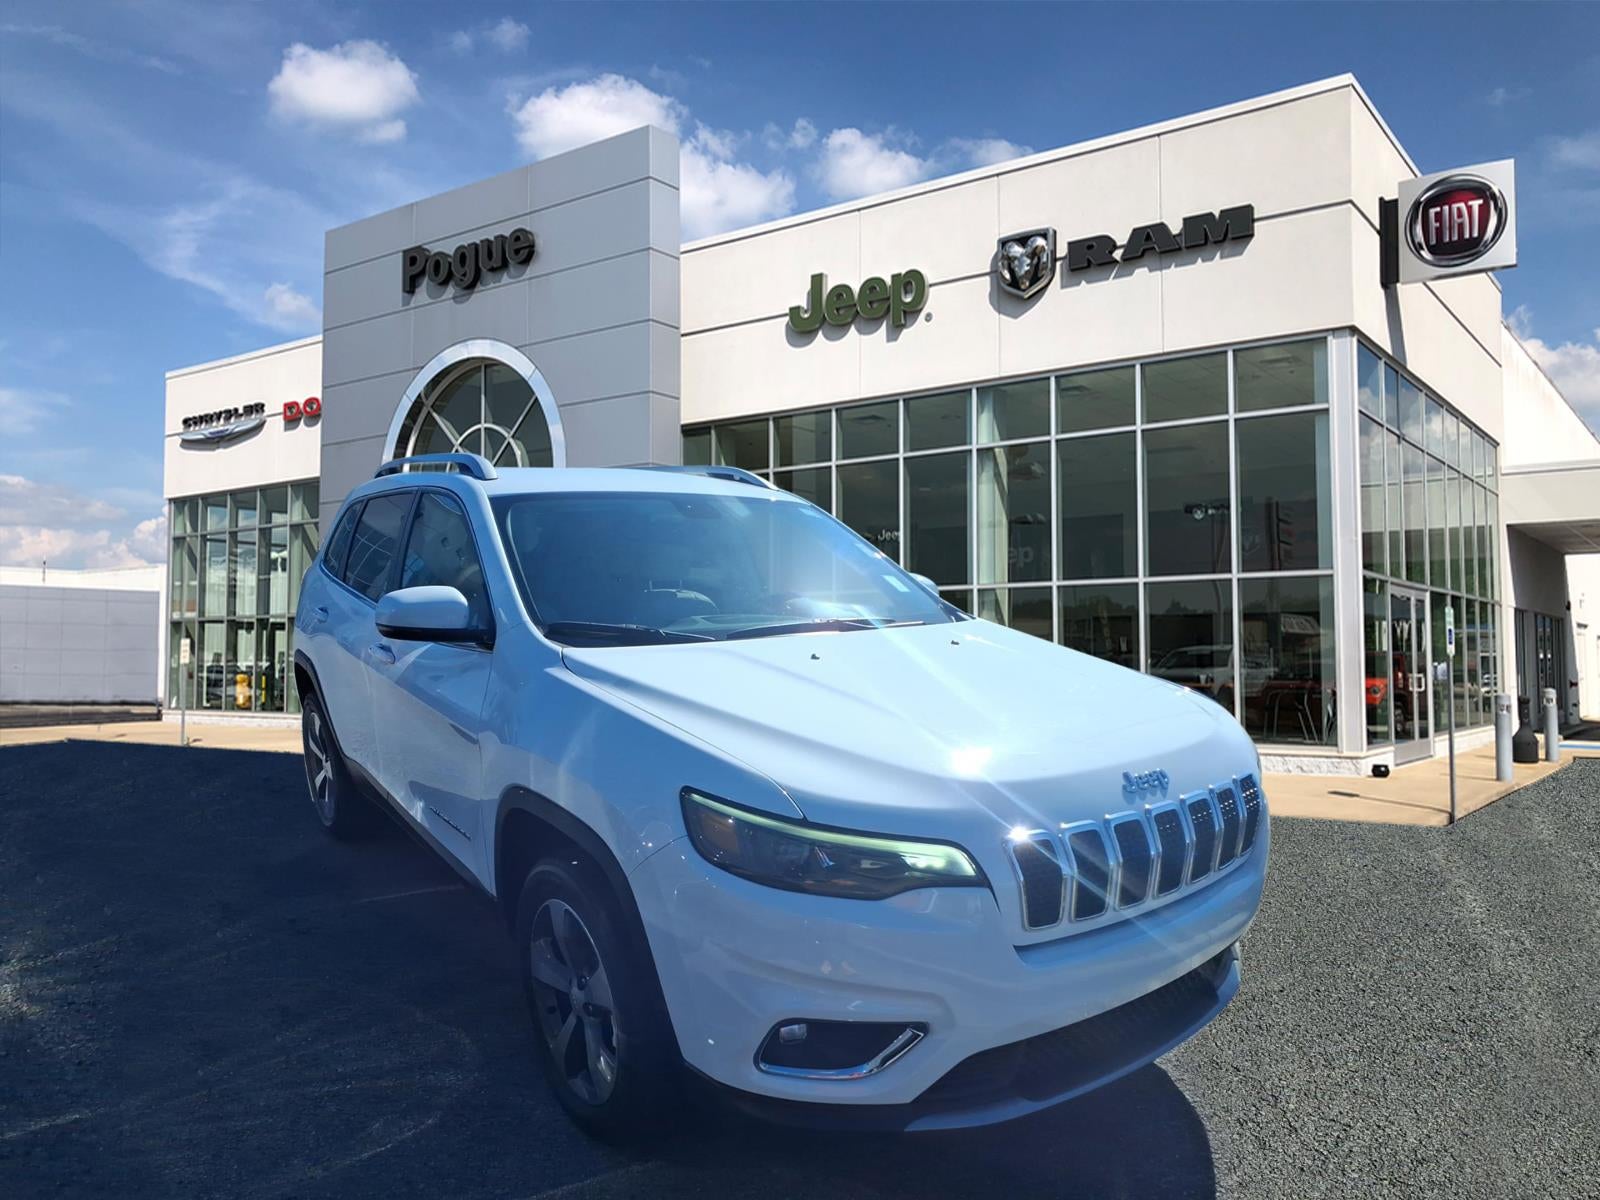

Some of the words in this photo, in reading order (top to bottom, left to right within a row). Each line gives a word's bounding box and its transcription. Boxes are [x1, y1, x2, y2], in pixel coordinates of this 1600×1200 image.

[1066, 203, 1255, 272] RAM
[1428, 199, 1484, 246] FIAT
[402, 227, 536, 294] Pogue
[788, 268, 927, 333] Jeep
[182, 402, 266, 428] CHRYSLER
[1121, 767, 1169, 793] Jeep
